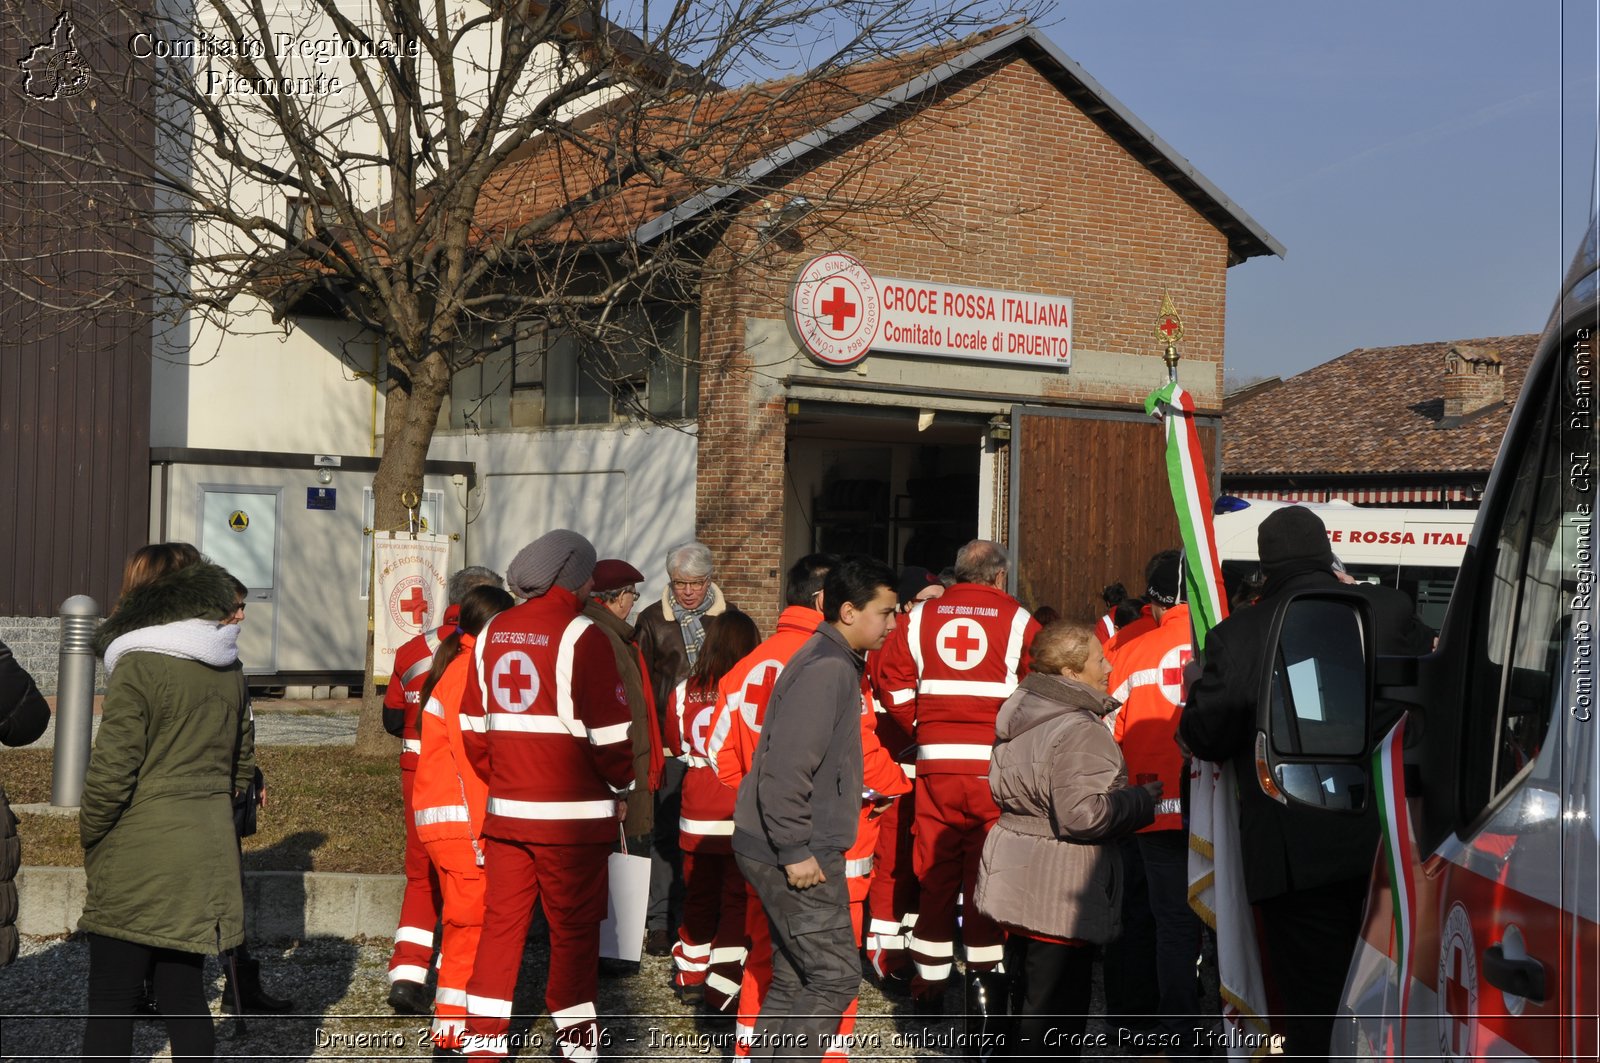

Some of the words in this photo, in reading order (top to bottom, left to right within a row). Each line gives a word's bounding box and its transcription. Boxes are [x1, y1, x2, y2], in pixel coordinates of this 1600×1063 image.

[812, 269, 822, 281] DI
[860, 278, 871, 292] 22
[883, 285, 937, 315] CROCE
[944, 292, 996, 321] ROSSA
[1002, 298, 1069, 328] ITALIANA
[866, 295, 876, 335] AGOSTO
[847, 336, 866, 353] 1864
[884, 320, 942, 347] Comitato
[947, 326, 988, 351] Locale
[992, 331, 1003, 352] di
[1008, 333, 1069, 359] DRUENTO
[1349, 531, 1416, 544] ROSSA
[1423, 533, 1472, 545] ITAL
[398, 555, 424, 567] ROSSA
[937, 605, 955, 614] CROCE
[955, 606, 974, 615] ROSSA
[973, 606, 999, 618] ITALIANA
[491, 632, 510, 644] CROCE
[509, 632, 527, 644] ROSSA
[526, 633, 550, 646] ITALIANA
